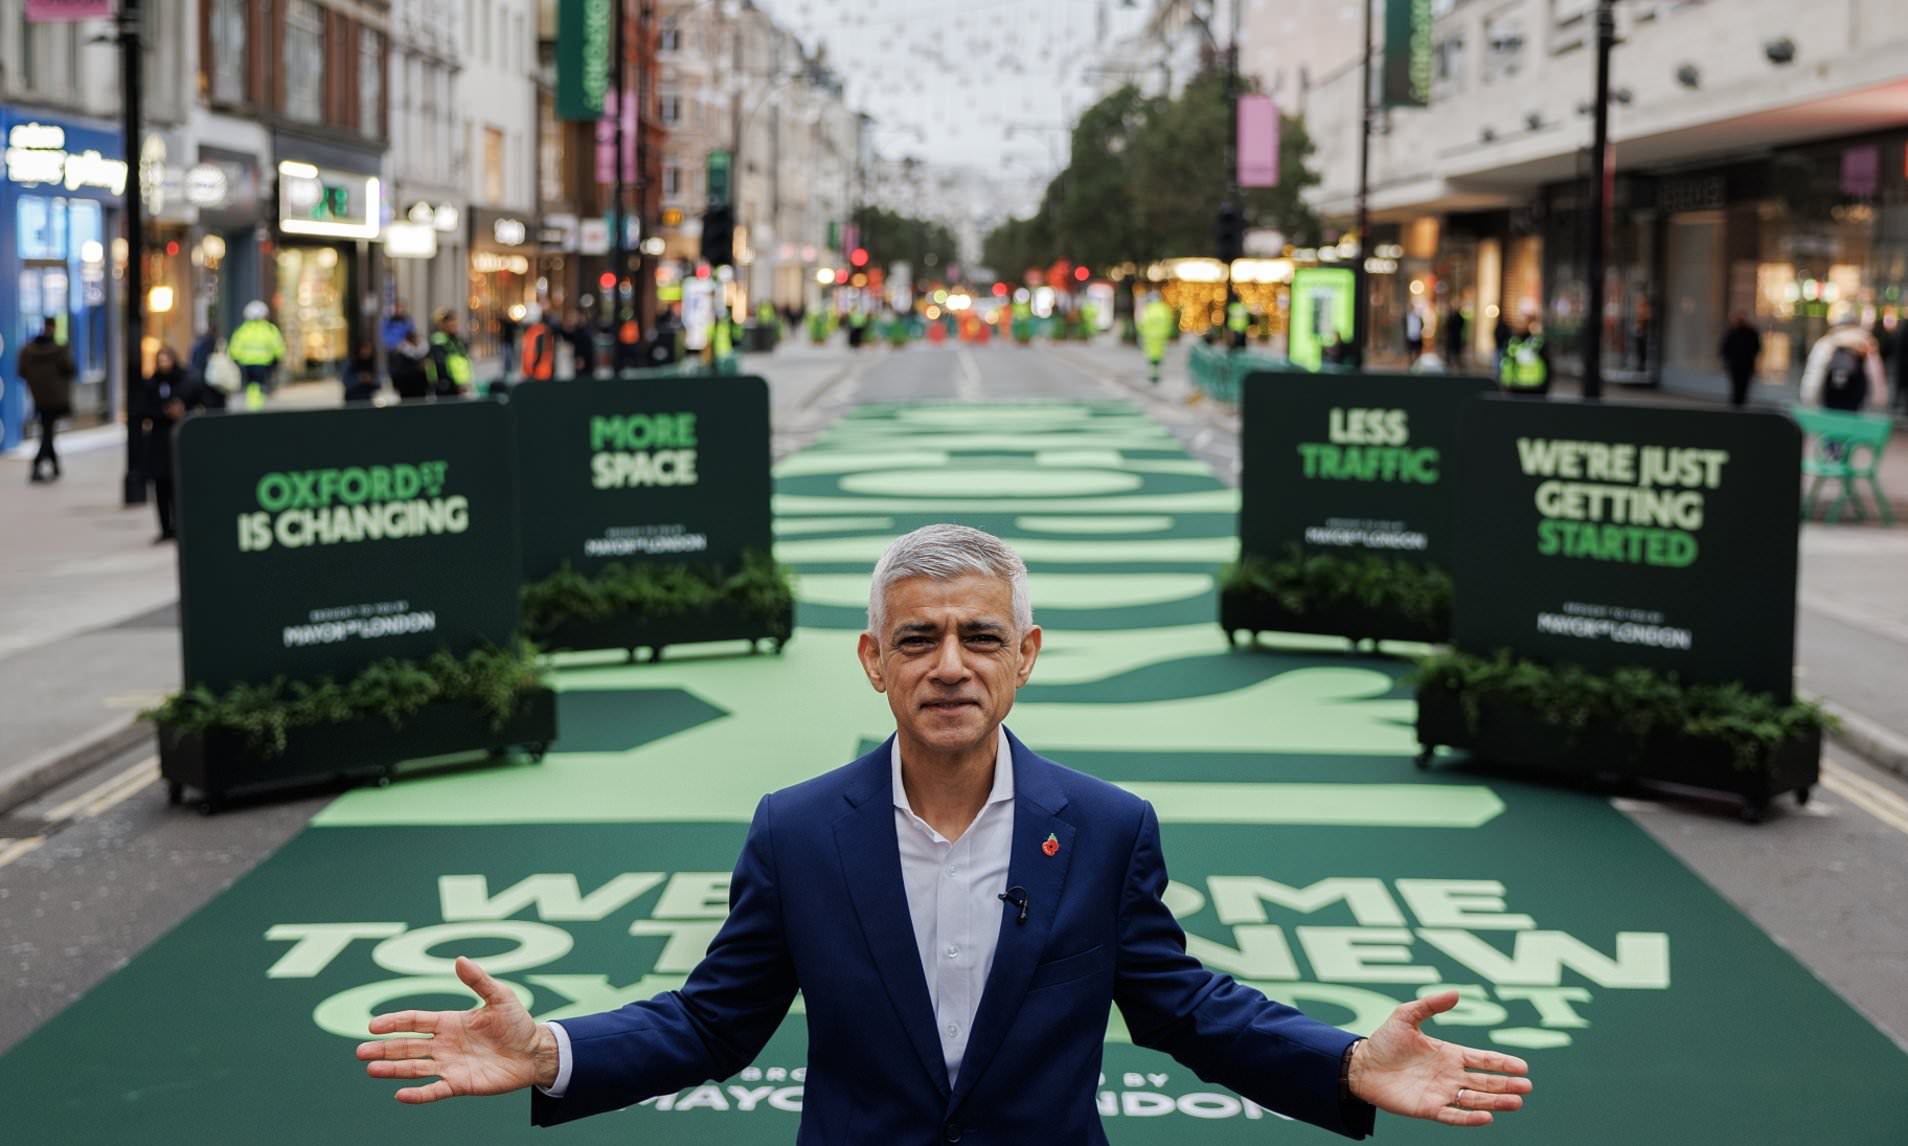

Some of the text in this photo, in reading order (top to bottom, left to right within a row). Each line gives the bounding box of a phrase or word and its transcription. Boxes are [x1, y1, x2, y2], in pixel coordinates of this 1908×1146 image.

[591, 413, 698, 450] MORE
[1329, 407, 1409, 446] LESS
[592, 449, 698, 489] SPACE
[1297, 443, 1440, 484] TRAFFIC
[1517, 437, 1729, 489] WE'RE JUST
[238, 495, 469, 551] IS CHANGING
[1534, 480, 1704, 530] GETTING
[1537, 518, 1698, 567] STARTED
[265, 919, 575, 978] TO
[1123, 1072, 1169, 1088] BY
